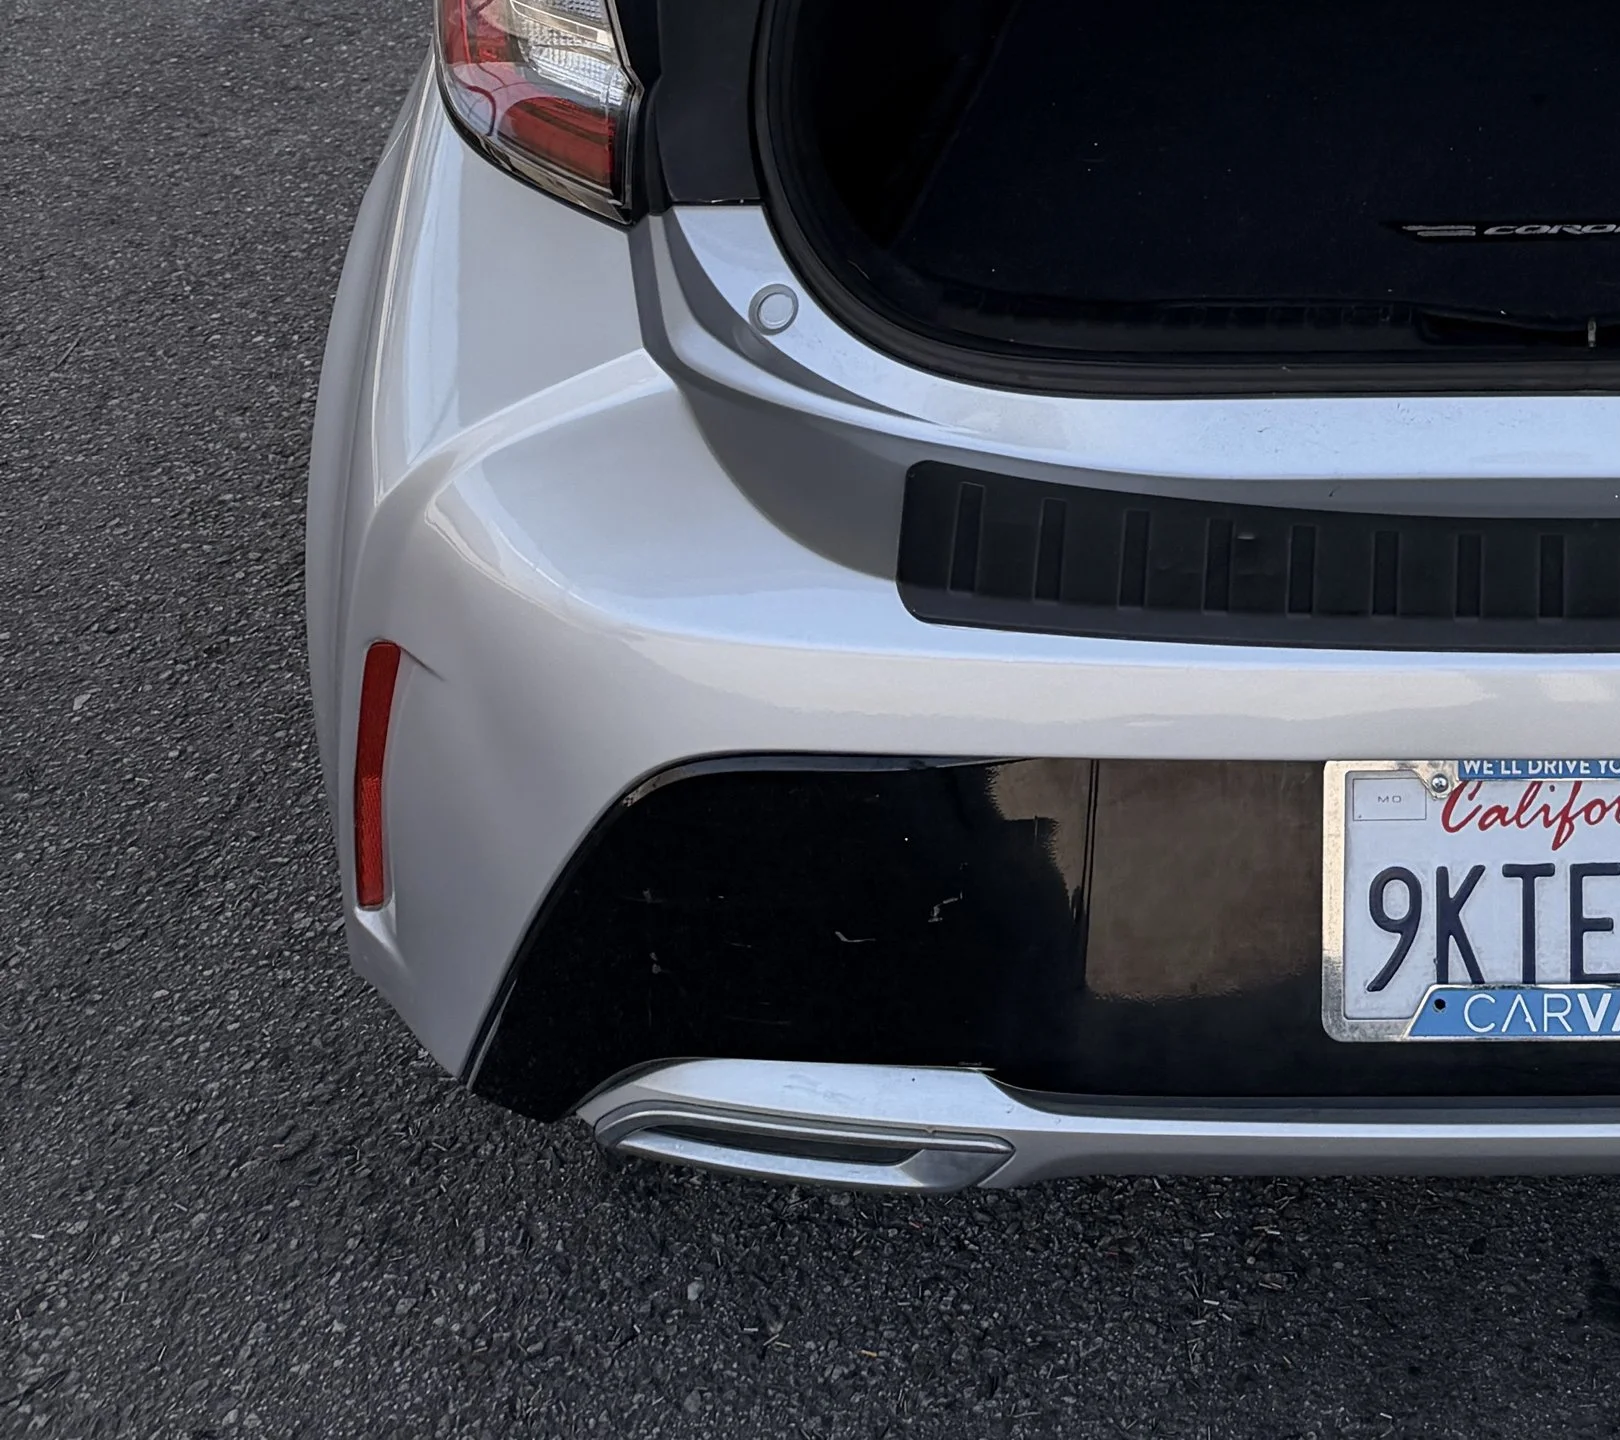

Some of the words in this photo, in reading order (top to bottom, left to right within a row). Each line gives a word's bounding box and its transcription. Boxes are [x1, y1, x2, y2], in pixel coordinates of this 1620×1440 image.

[1463, 760, 1522, 775] WELL
[1528, 760, 1591, 775] DRIVE
[1377, 795, 1402, 804] MO
